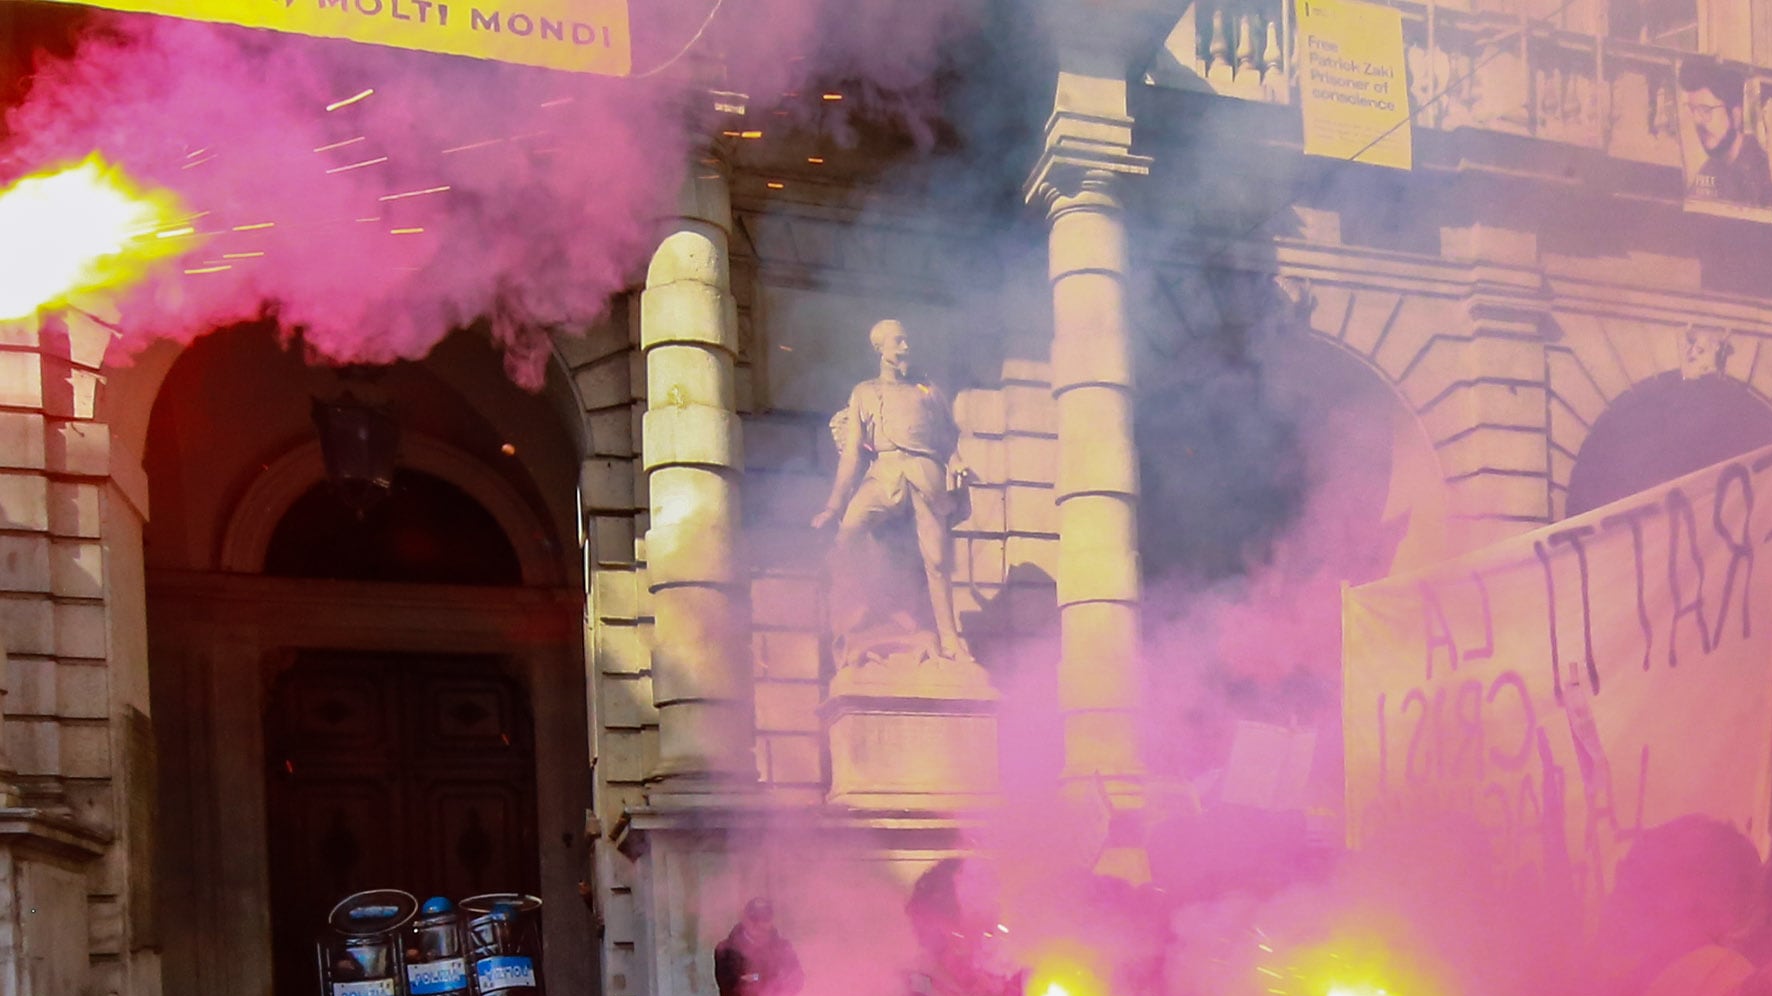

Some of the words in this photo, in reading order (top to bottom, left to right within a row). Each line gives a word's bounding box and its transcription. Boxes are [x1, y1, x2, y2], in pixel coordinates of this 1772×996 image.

[470, 8, 611, 48] MONDI
[1308, 35, 1338, 51] Free
[1309, 52, 1359, 72] Patrick
[1364, 63, 1394, 79] Zaki
[1311, 69, 1370, 91] Prisoner
[1374, 82, 1388, 95] of
[1312, 88, 1395, 112] conscience
[414, 969, 461, 986] POLIZIA
